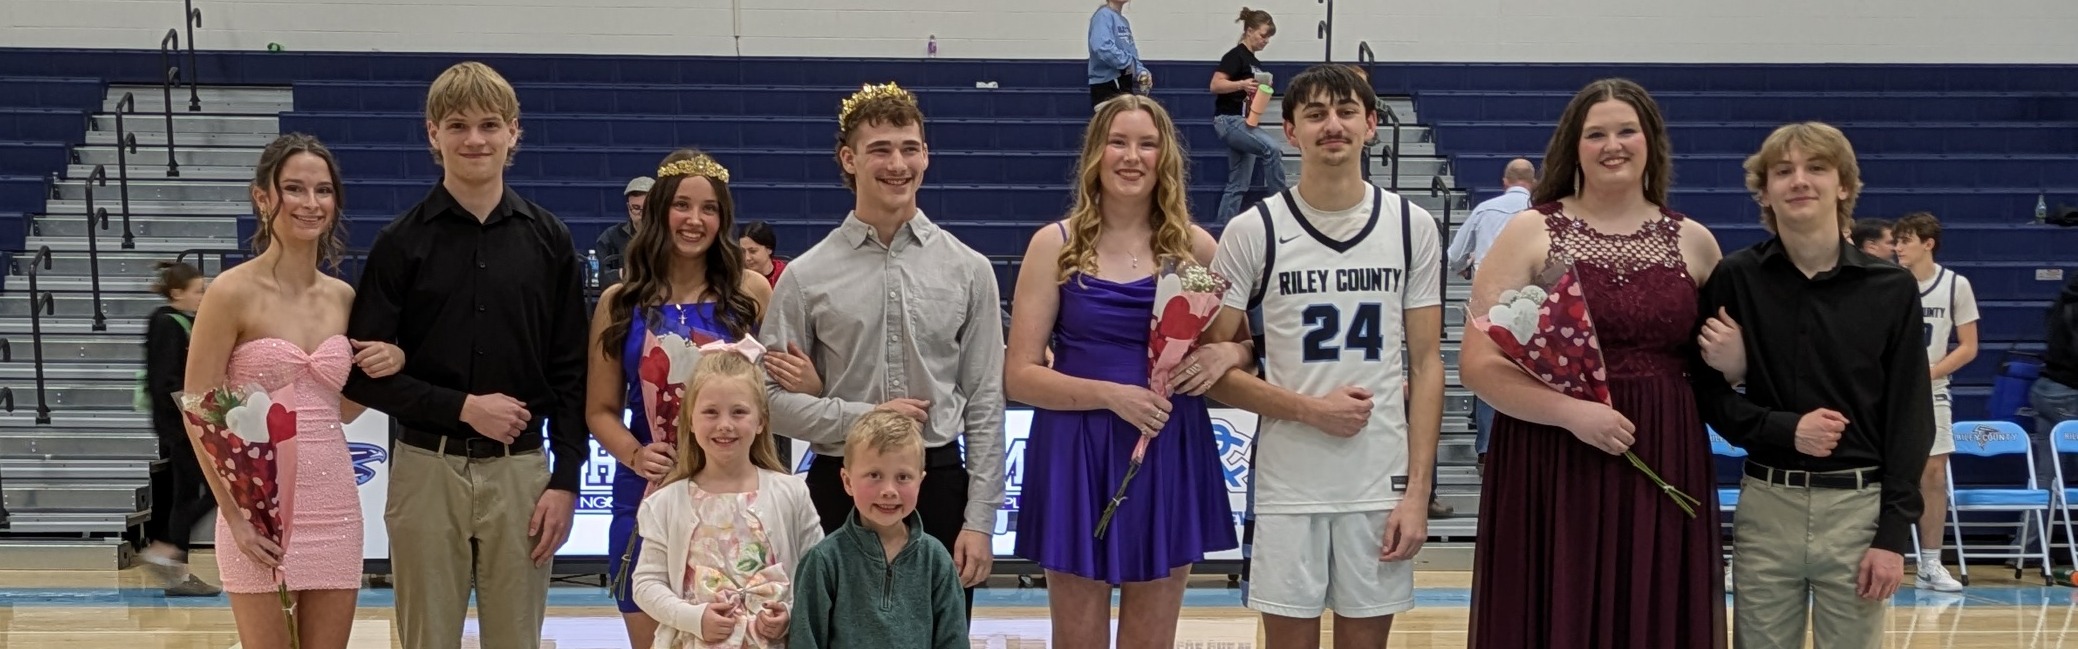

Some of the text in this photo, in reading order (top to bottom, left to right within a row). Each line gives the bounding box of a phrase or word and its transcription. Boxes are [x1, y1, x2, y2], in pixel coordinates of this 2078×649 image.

[1278, 268, 1403, 296] RILEY COUNTY
[1301, 302, 1384, 363] 24
